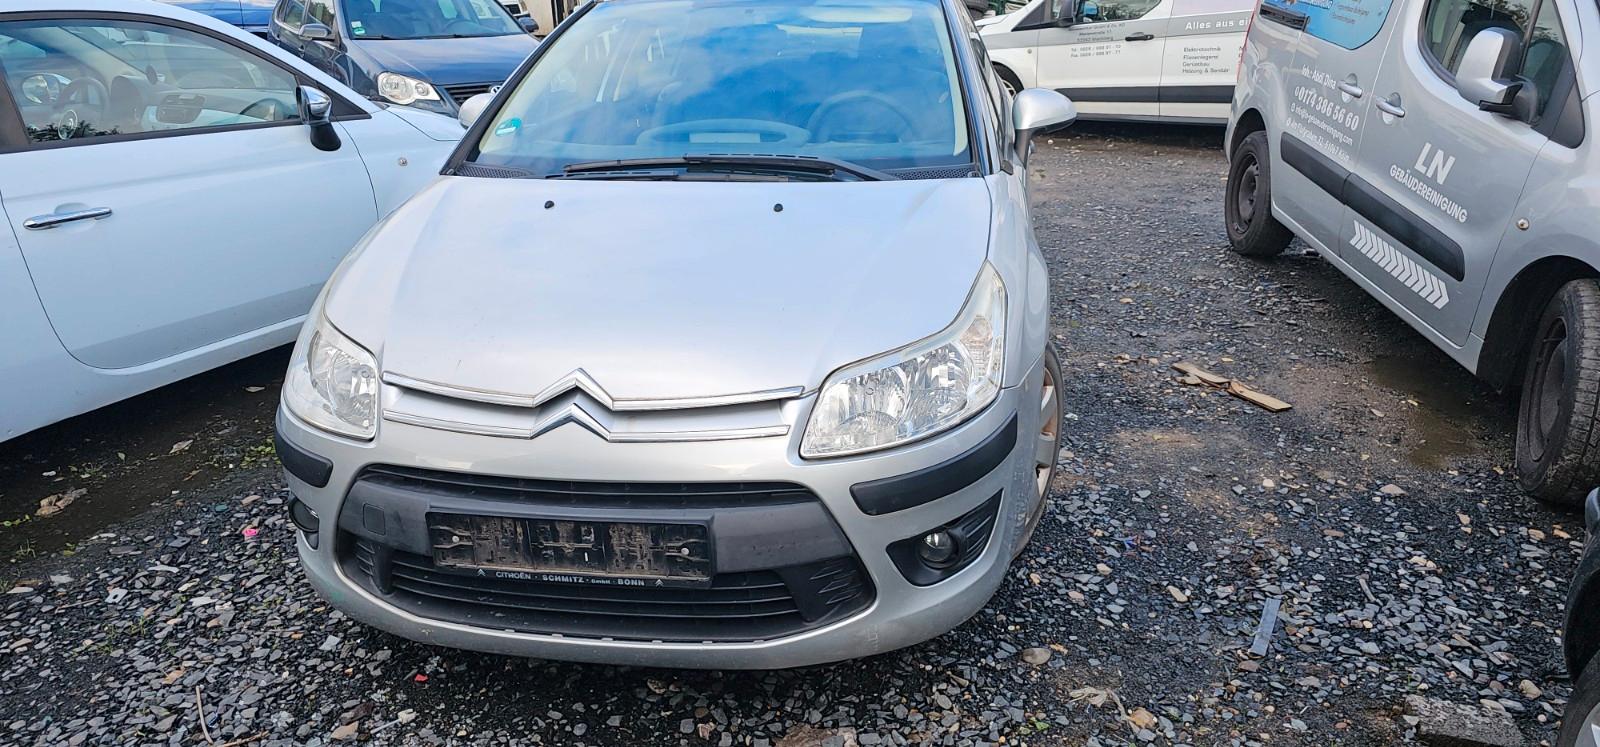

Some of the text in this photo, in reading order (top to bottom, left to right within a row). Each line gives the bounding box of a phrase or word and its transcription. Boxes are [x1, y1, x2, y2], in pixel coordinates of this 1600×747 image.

[1185, 21, 1212, 31] Alles
[1215, 20, 1234, 28] aus
[1298, 86, 1360, 131] 0174 386 56 60
[1414, 142, 1456, 185] LN
[1389, 164, 1468, 223] GEBÄUDEREINIGUNG
[542, 574, 585, 583] SCHMITZ
[617, 578, 645, 587] BONN
